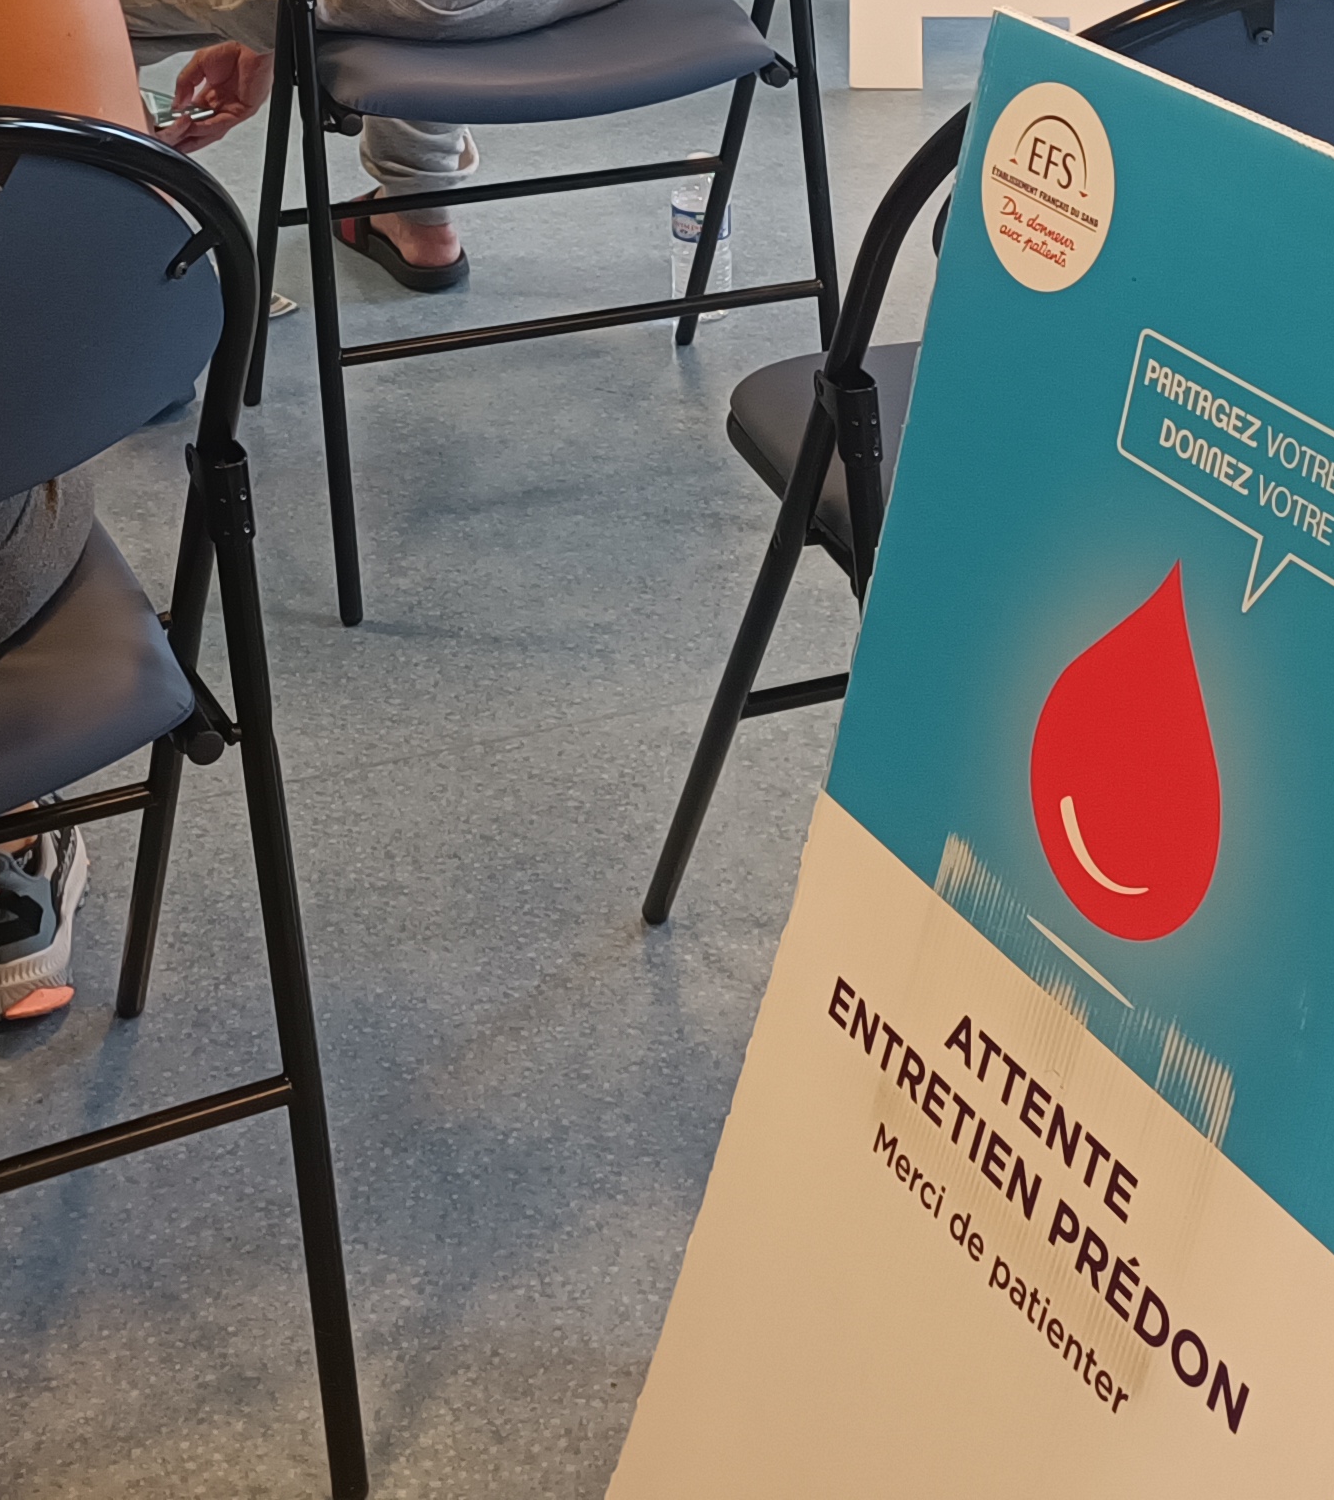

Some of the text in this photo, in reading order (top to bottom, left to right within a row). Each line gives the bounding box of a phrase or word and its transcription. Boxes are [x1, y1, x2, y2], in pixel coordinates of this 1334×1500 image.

[1027, 136, 1077, 190] EFS
[999, 224, 1067, 268] aux patients
[1000, 195, 1076, 251] Du donneur
[1070, 206, 1080, 218] DU
[1081, 212, 1098, 228] SANG
[1144, 358, 1262, 448] PARTAGEZ
[1159, 417, 1253, 496] DONNEZ
[944, 1014, 1139, 1225] ATTENTE
[827, 975, 1251, 1436] ENTRETIEN PRÉDON
[872, 1121, 1130, 1415] Merci de patienter
